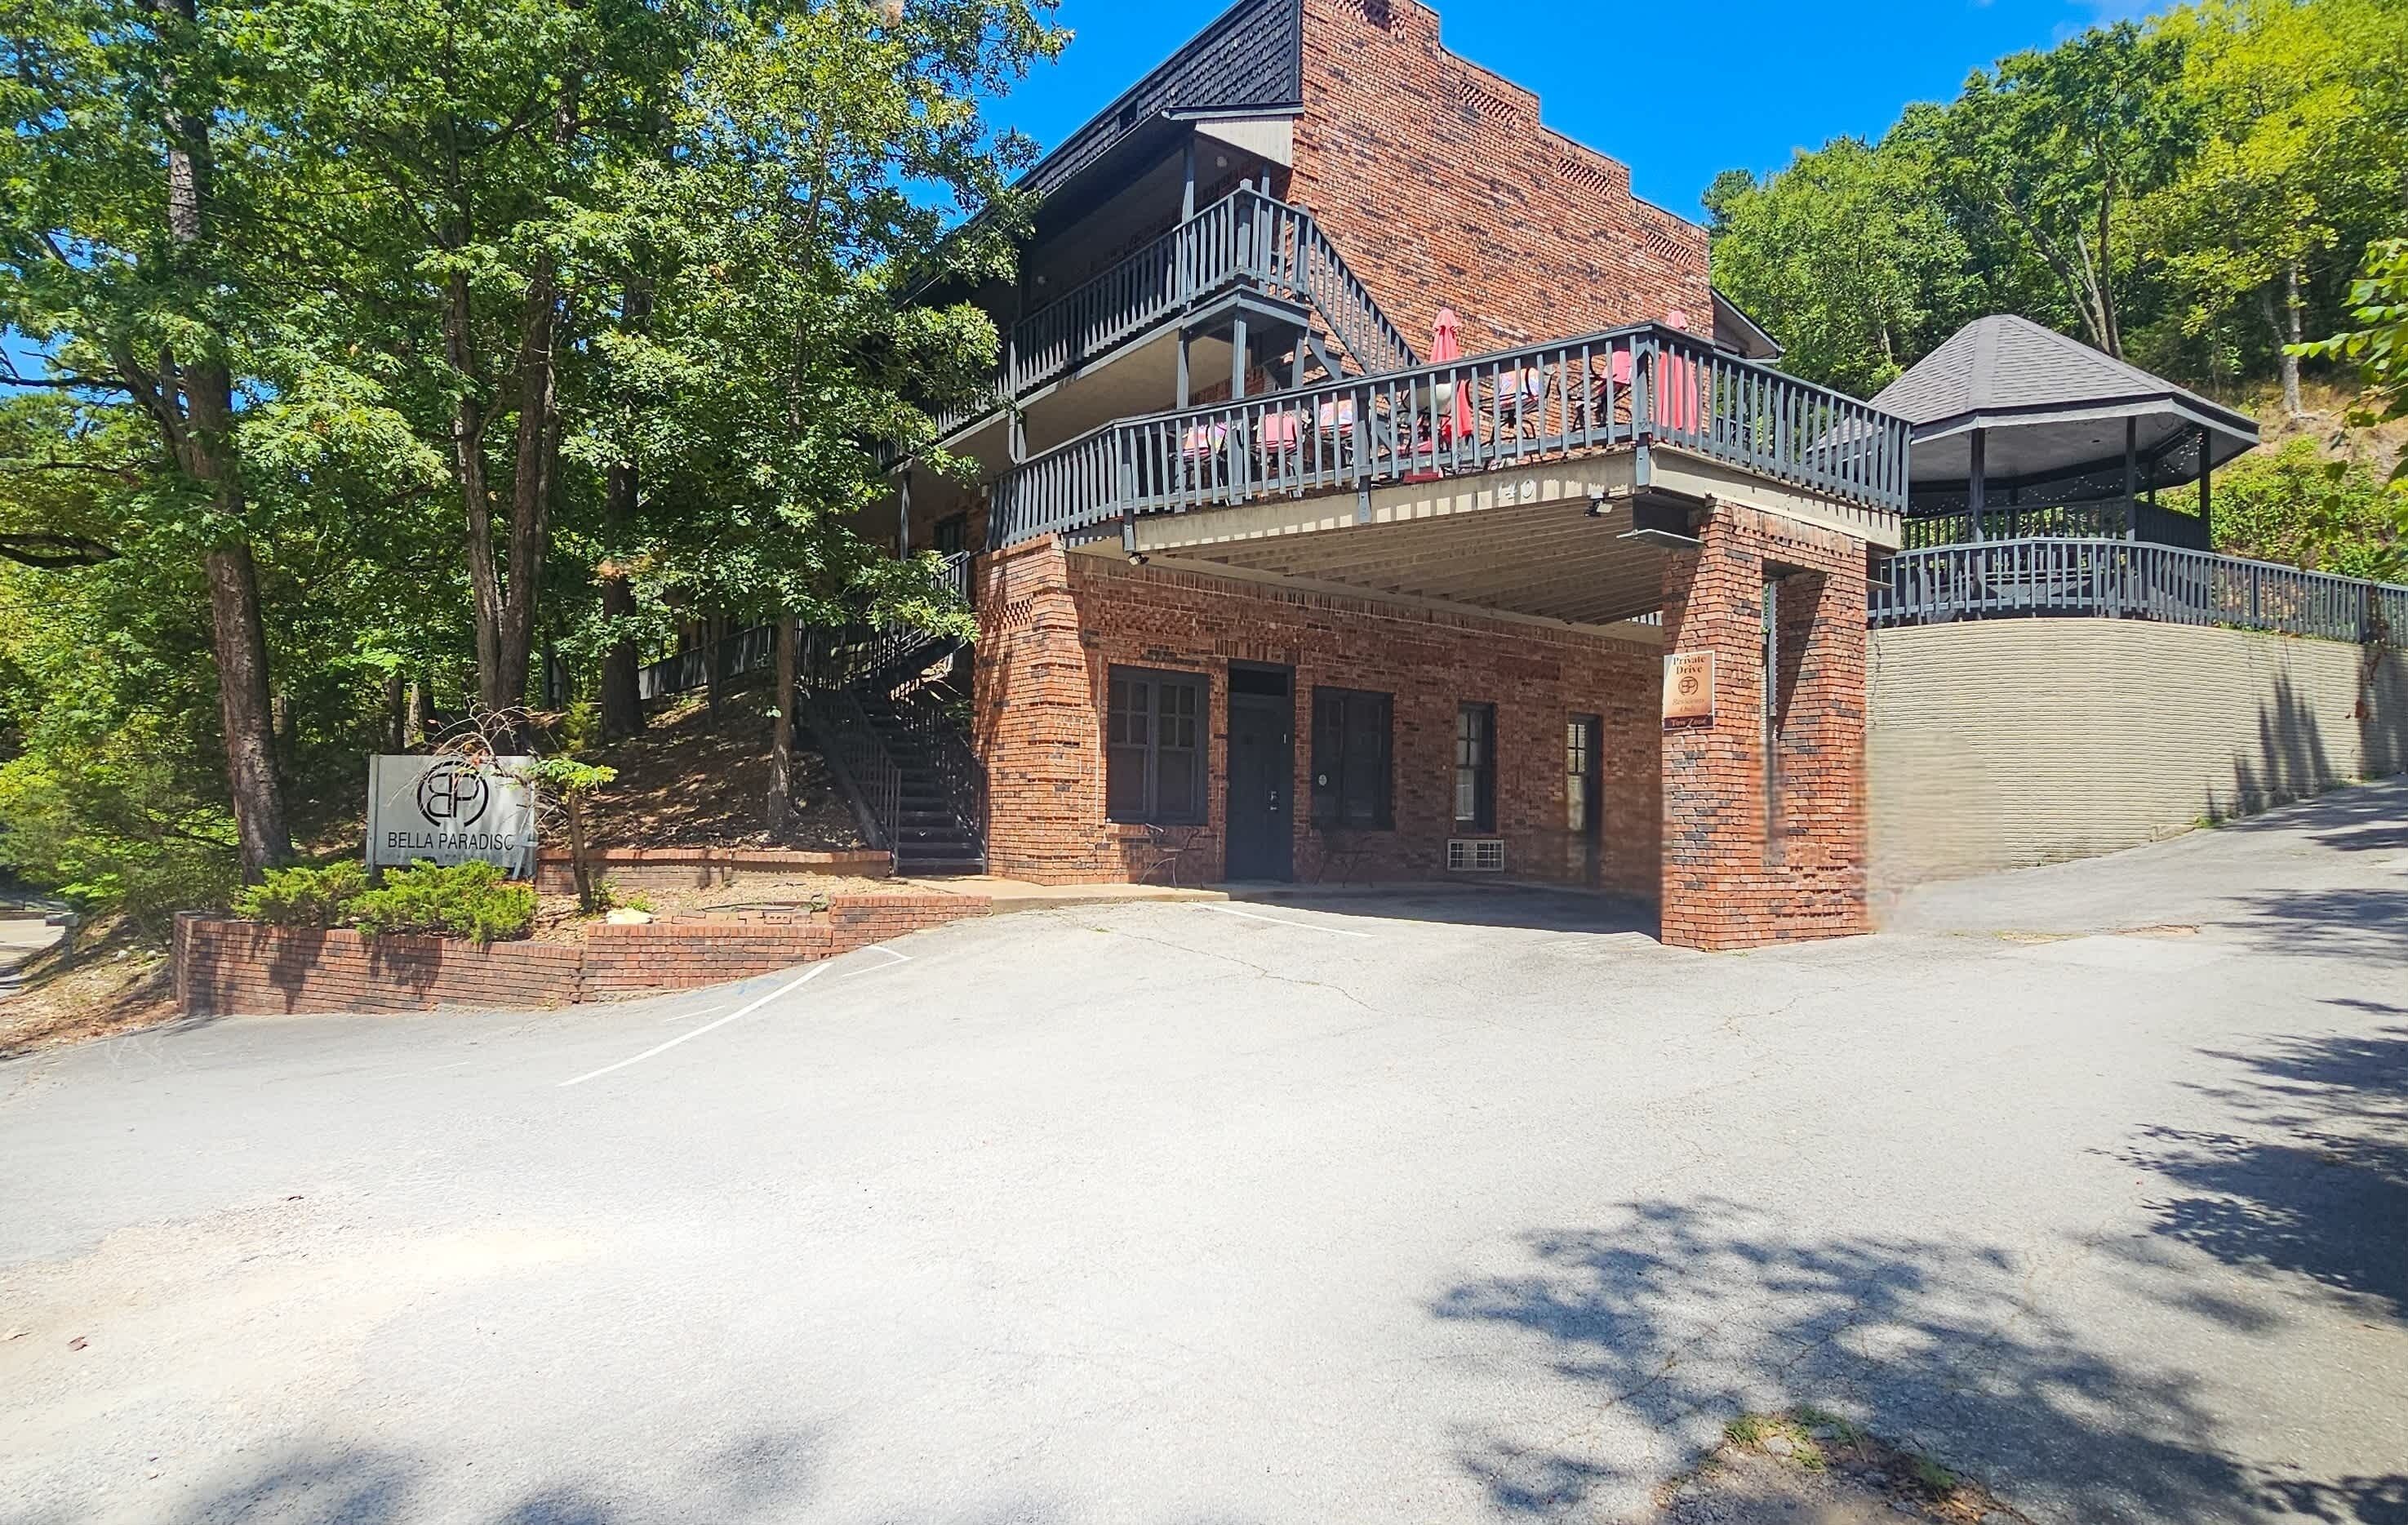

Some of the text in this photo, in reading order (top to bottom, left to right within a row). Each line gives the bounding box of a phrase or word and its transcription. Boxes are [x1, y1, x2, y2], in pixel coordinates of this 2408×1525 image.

[1673, 655, 1706, 665] Private
[1676, 665, 1704, 674] Drive
[1671, 718, 1686, 727] Tow
[388, 832, 433, 849] BELLA
